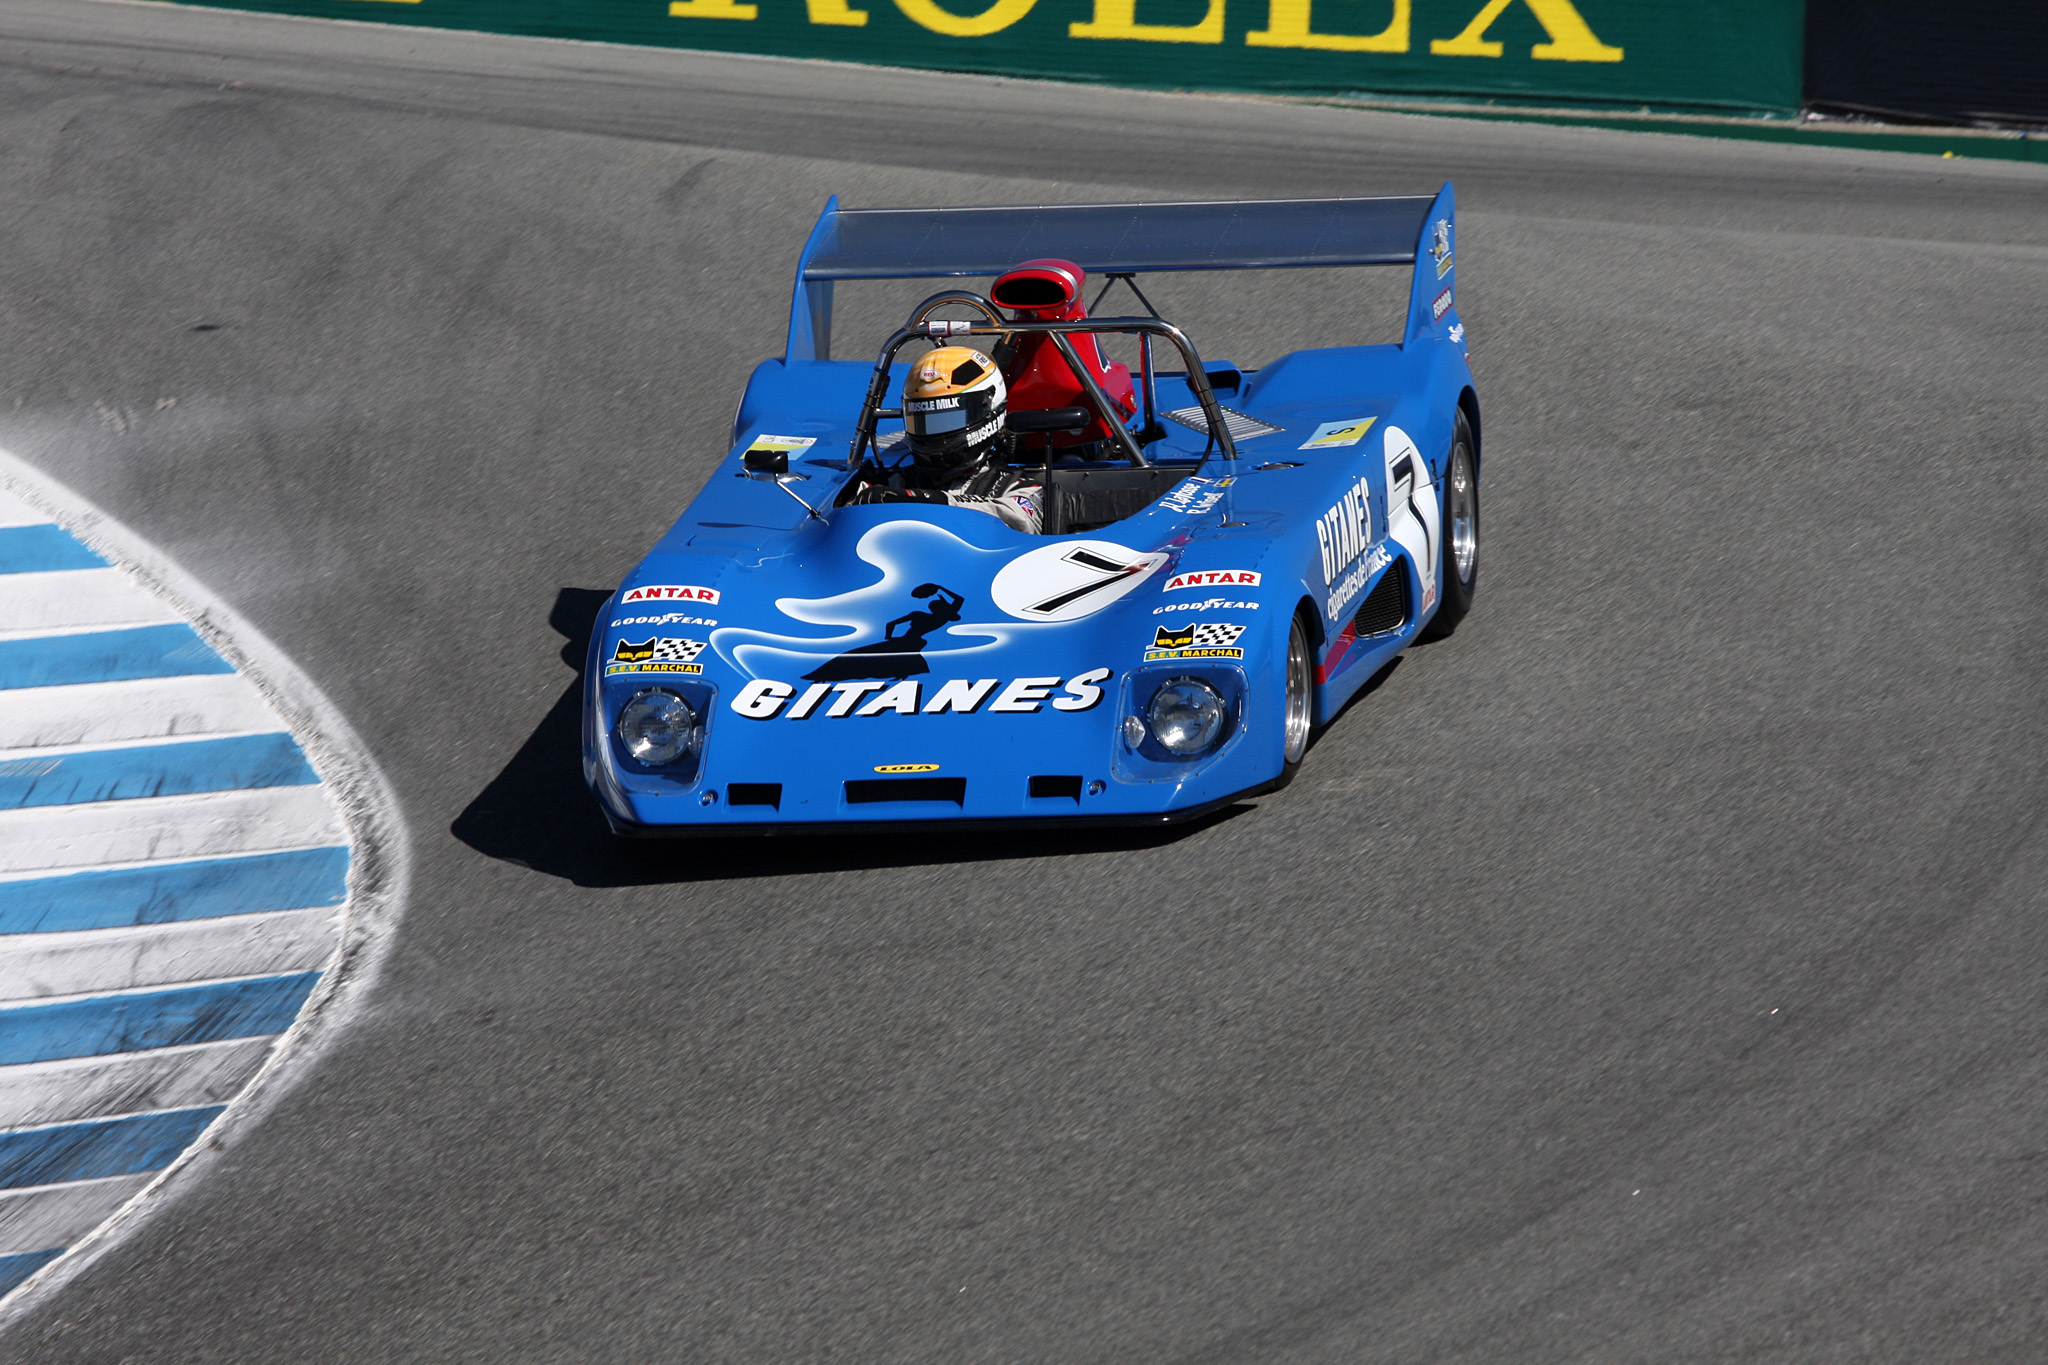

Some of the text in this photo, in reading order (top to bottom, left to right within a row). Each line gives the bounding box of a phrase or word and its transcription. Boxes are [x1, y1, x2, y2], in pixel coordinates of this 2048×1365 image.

[907, 397, 960, 412] MUSCLE MILK
[966, 420, 999, 447] MUSCLE
[1389, 447, 1431, 579] 7
[1316, 477, 1371, 586] GITANES
[1022, 546, 1157, 615] 7
[1168, 573, 1256, 589] ANTAR
[626, 588, 713, 601] ANTAR
[1327, 572, 1358, 621] cigarettes
[1152, 599, 1260, 615] GOODYEAR
[611, 613, 718, 627] GOODYEAR
[1182, 649, 1240, 658] MARCHAL
[641, 664, 699, 673] MARCHAL
[731, 667, 1112, 721] GITANES
